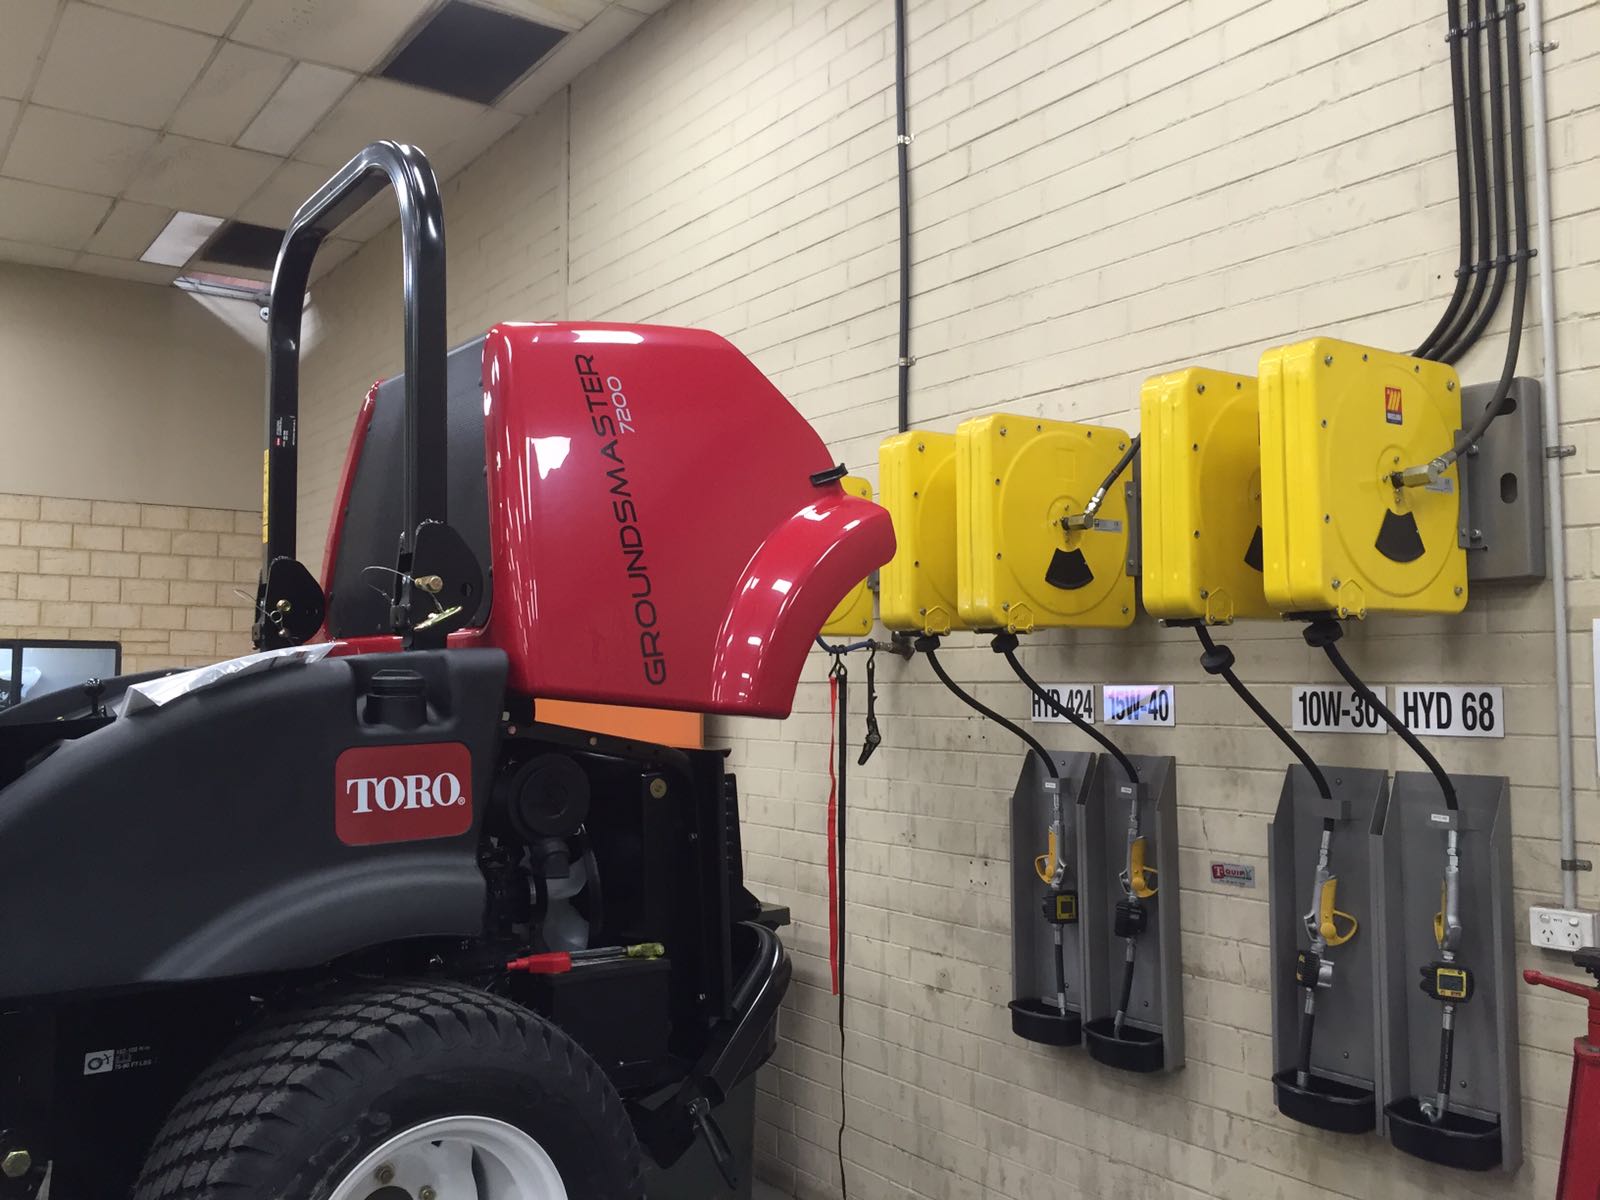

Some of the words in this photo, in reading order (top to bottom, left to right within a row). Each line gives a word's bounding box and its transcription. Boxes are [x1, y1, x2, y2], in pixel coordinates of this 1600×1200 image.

[606, 375, 635, 434] 7200
[575, 353, 667, 685] GROUNDSMASTER
[1066, 689, 1093, 719] 424
[1109, 690, 1169, 721] 15W-40
[1298, 690, 1379, 728] 10W-30
[1403, 691, 1452, 729] HYD
[1461, 692, 1495, 732] 68
[346, 772, 461, 814] TORO
